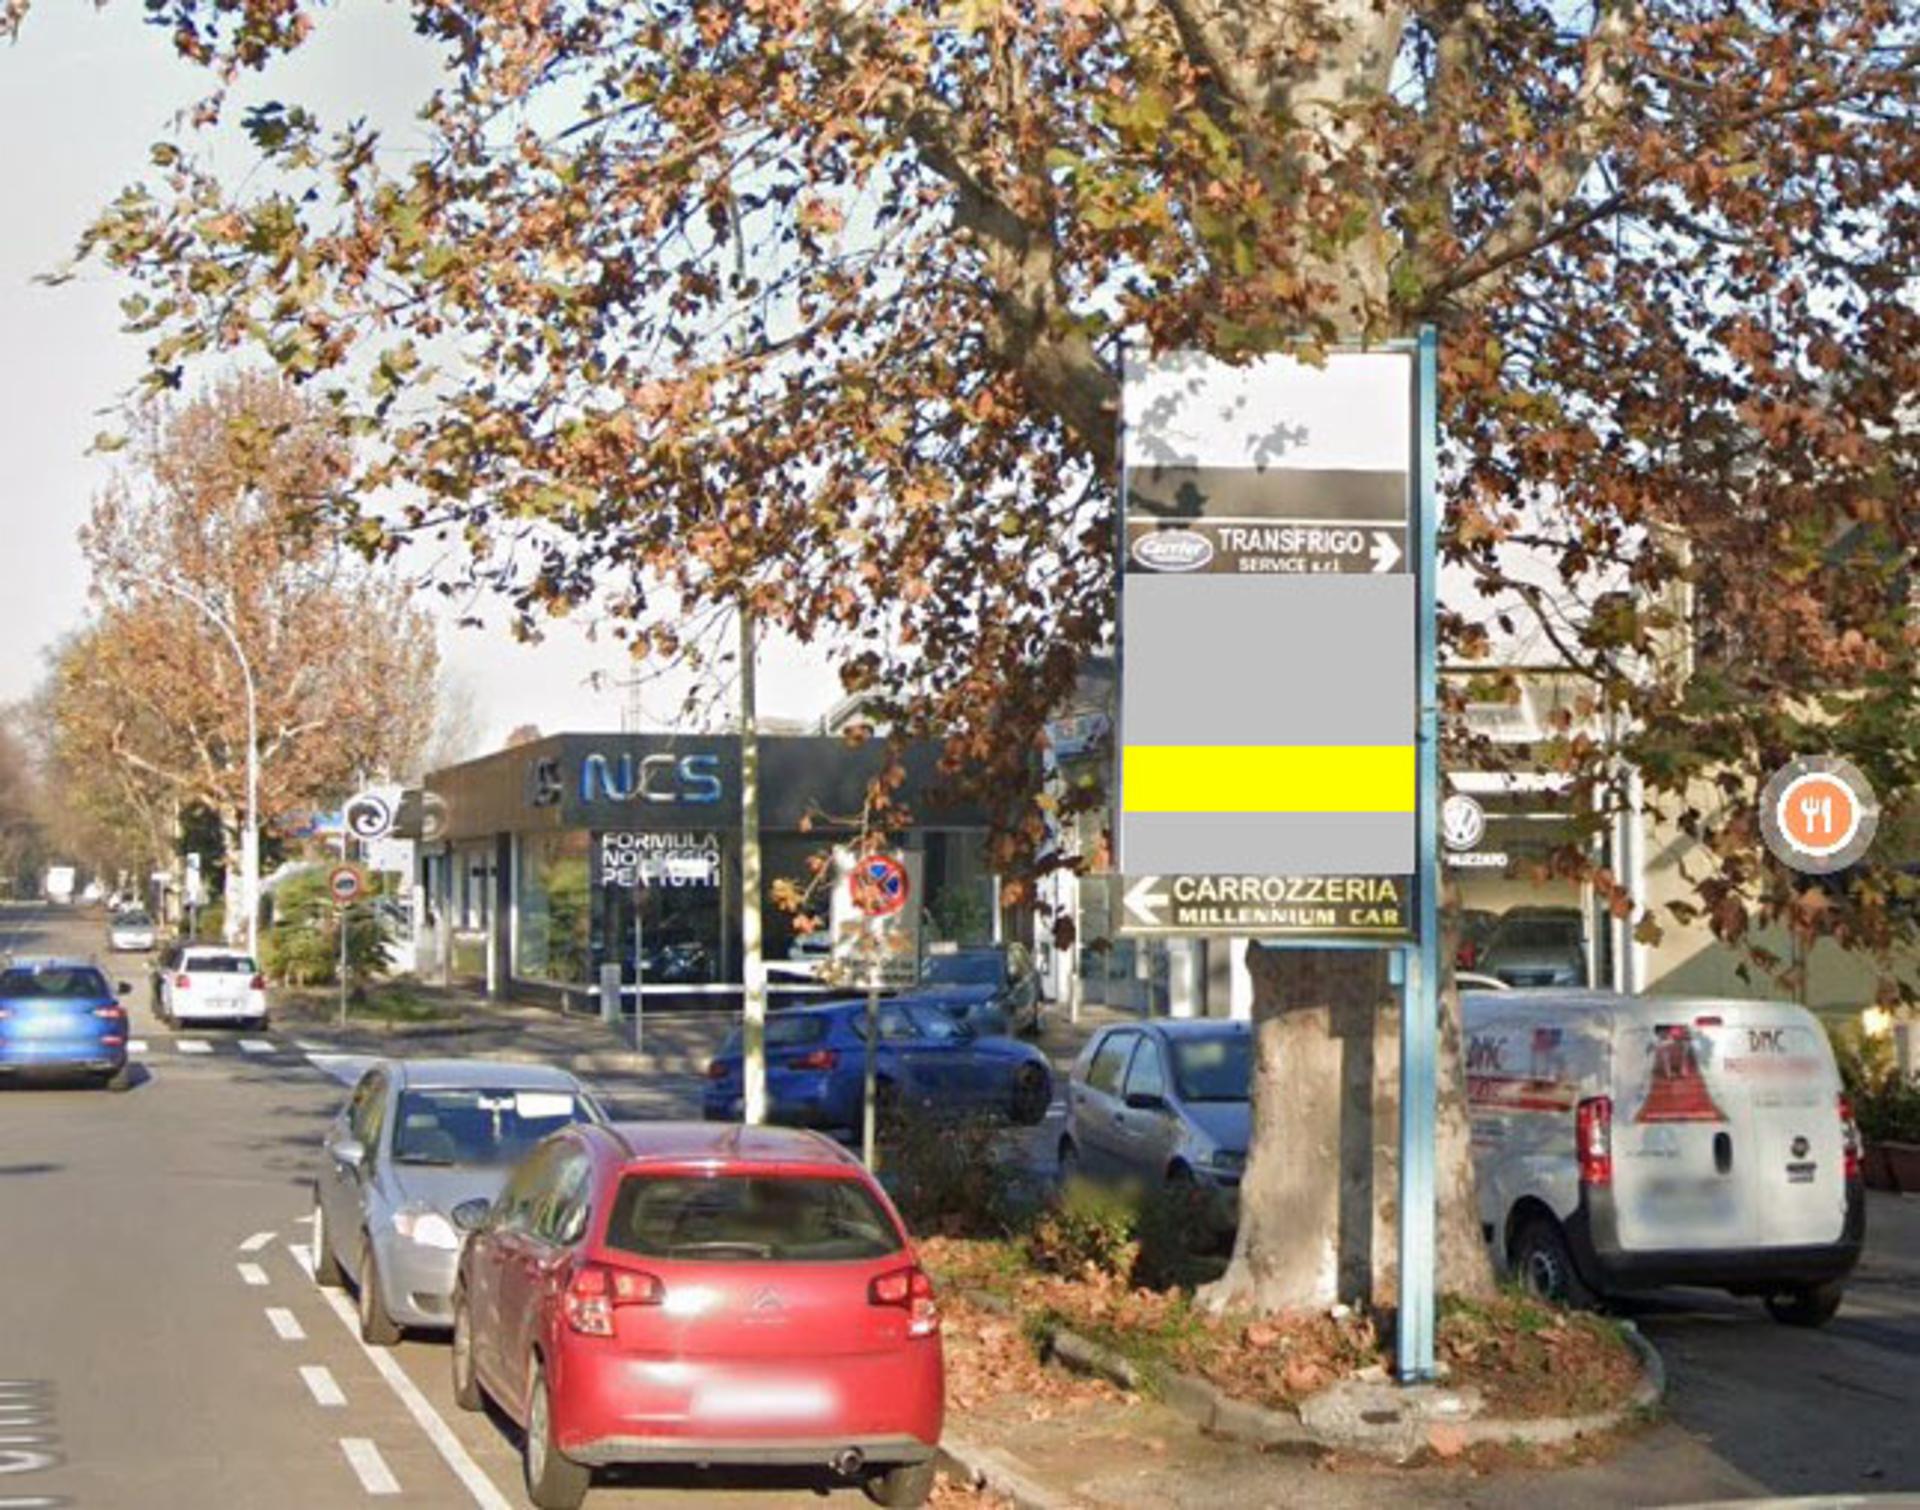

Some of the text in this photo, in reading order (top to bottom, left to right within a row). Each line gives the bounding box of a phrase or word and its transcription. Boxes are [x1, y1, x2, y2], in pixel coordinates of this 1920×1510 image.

[1218, 528, 1365, 554] TRANSFRIGO
[1239, 557, 1308, 572] SERVICE
[580, 753, 722, 802] NCS
[602, 832, 719, 849] FORMULA
[1173, 876, 1398, 902] CARROZZERIA
[1179, 908, 1399, 925] MILLENNIUM CAR
